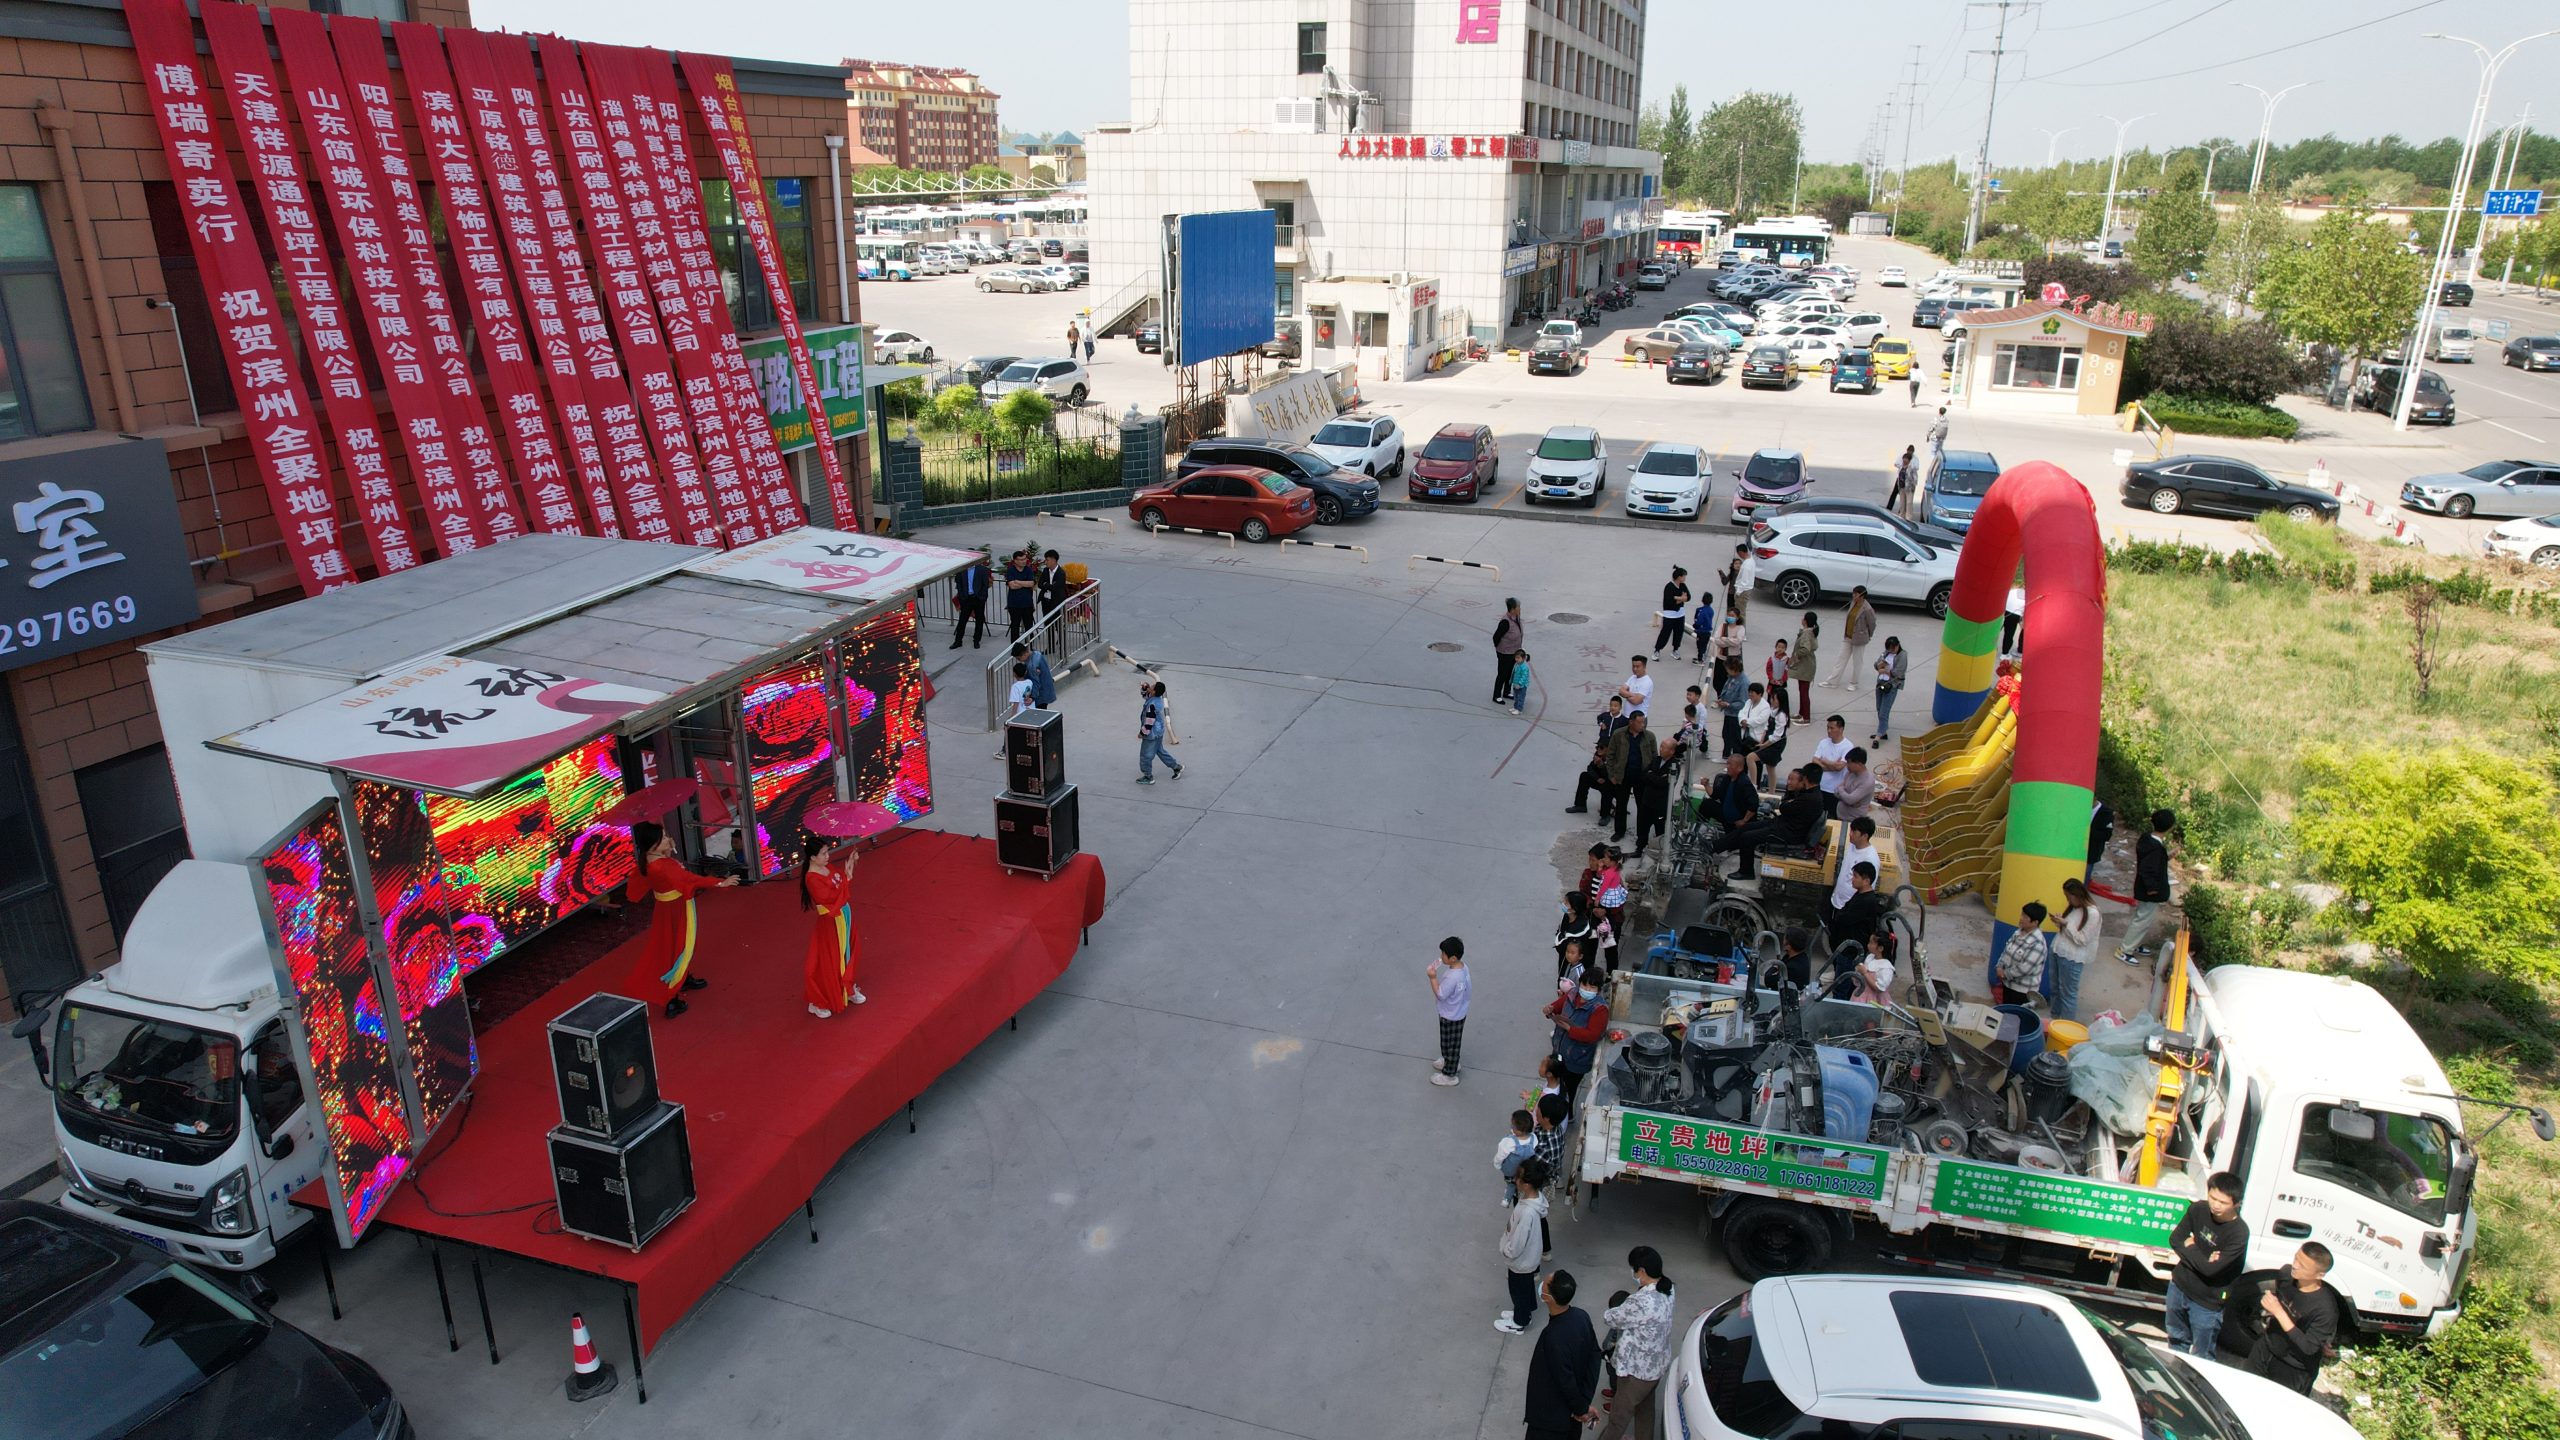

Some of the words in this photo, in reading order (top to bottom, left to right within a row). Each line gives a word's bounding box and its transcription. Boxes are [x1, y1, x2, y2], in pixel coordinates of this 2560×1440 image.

[155, 63, 237, 243] 博瑞寄卖行
[308, 87, 424, 385] 山东简城环保科技有限公司
[359, 83, 472, 396] 阳信汇鑫肉类加工设备有限公司
[422, 90, 523, 362] 滨州大霖装饰工程有限公司
[472, 88, 576, 376] 平原铭德建筑装饰工程有限公司
[511, 87, 621, 380] 阳信县名饰嘉园装饰工程有限公司
[561, 89, 657, 345] 山东固耐德地坪工程有限公司
[601, 99, 700, 352] 淄博鲁米特建筑材料有限公司
[633, 94, 713, 325] 滨州富洋地坪工程有限公司
[659, 102, 722, 307] 阳信县怡然古典家具厂
[1338, 137, 1427, 158] 人力大数据
[235, 72, 362, 399] 天津祥源通地坪工程有限公司
[346, 428, 416, 570] 祝贺滨州全聚
[1634, 1120, 1768, 1160] 立贵地坪
[1674, 1153, 1769, 1180] 15550228612
[1780, 1169, 1876, 1195] 17661181222
